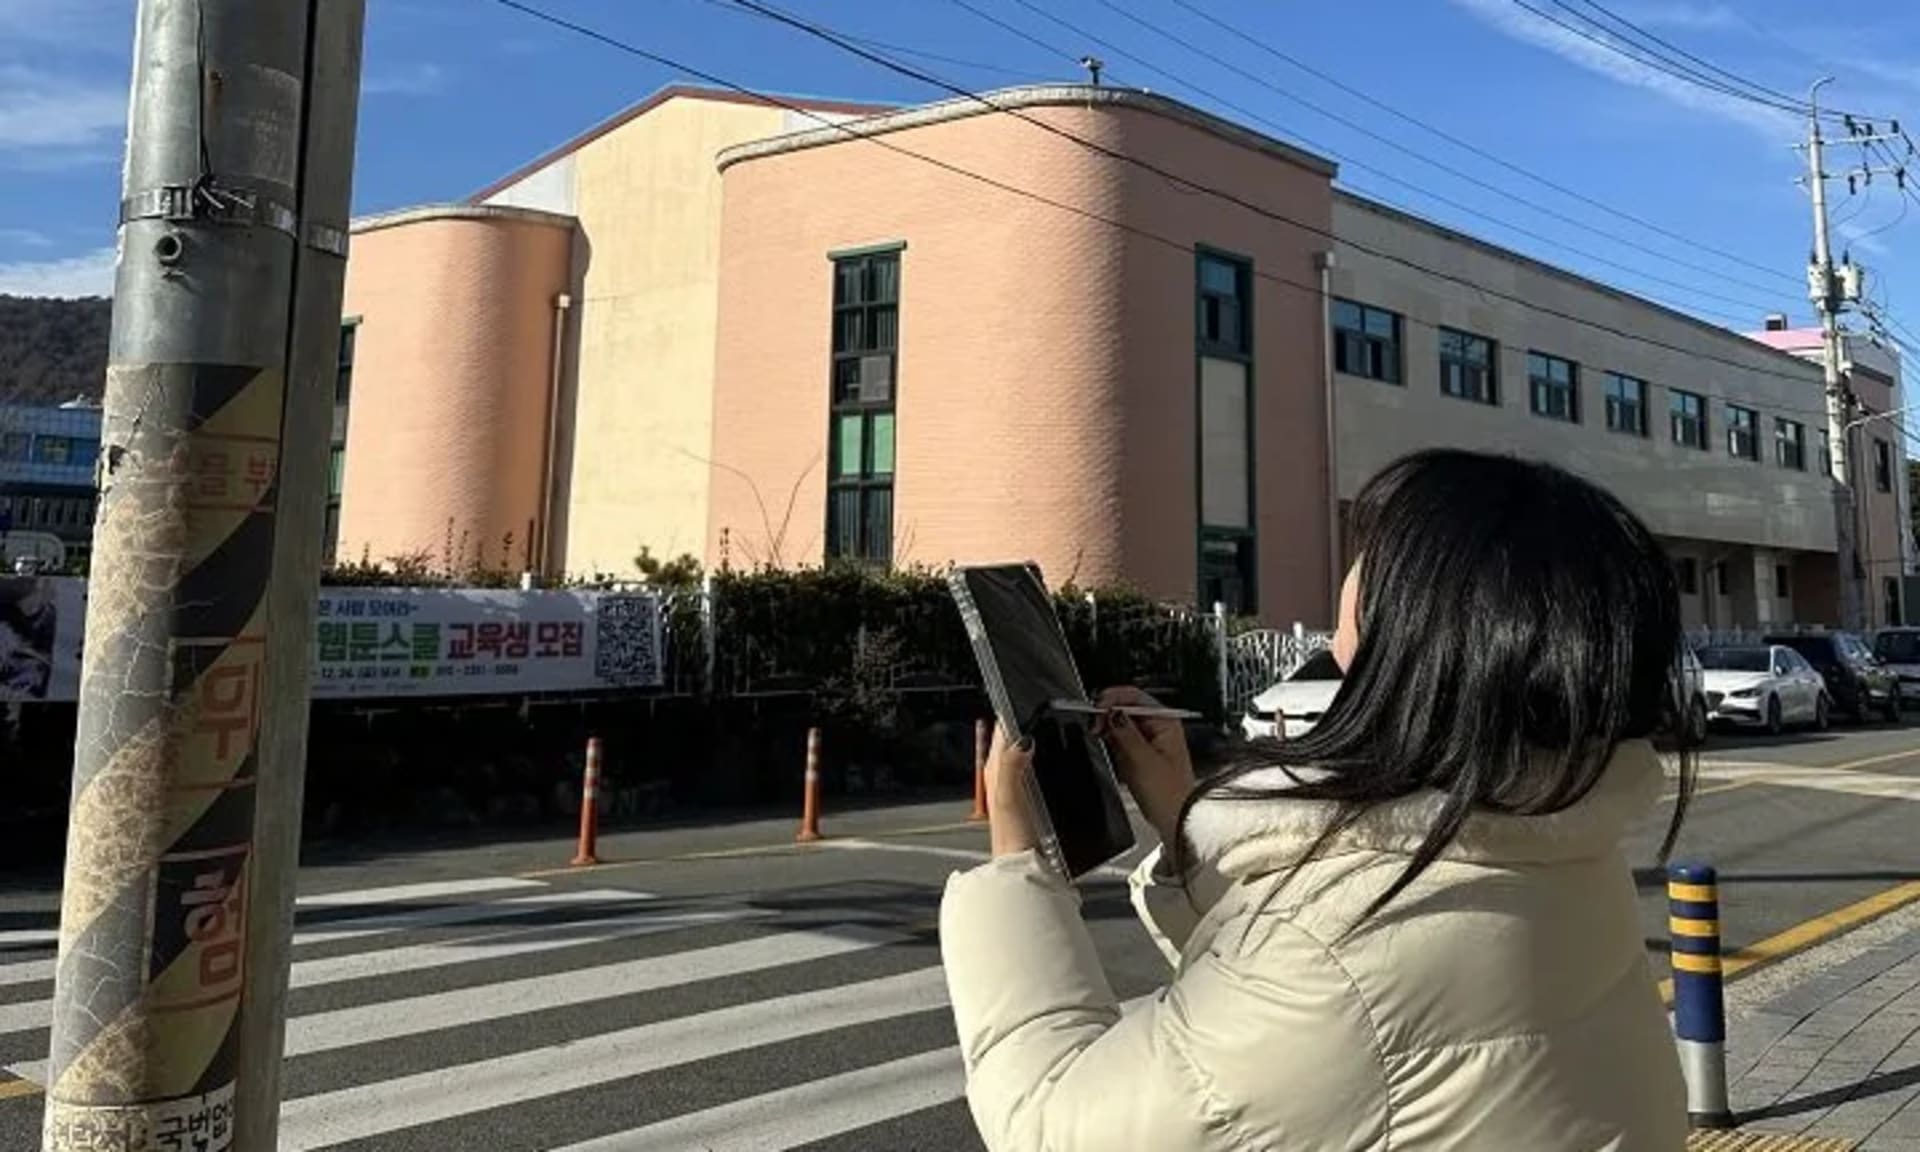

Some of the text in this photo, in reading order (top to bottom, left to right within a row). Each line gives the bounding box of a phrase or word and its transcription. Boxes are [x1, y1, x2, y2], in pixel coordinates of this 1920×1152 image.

[318, 620, 584, 661] 웹툰스쿨 교육생 모집
